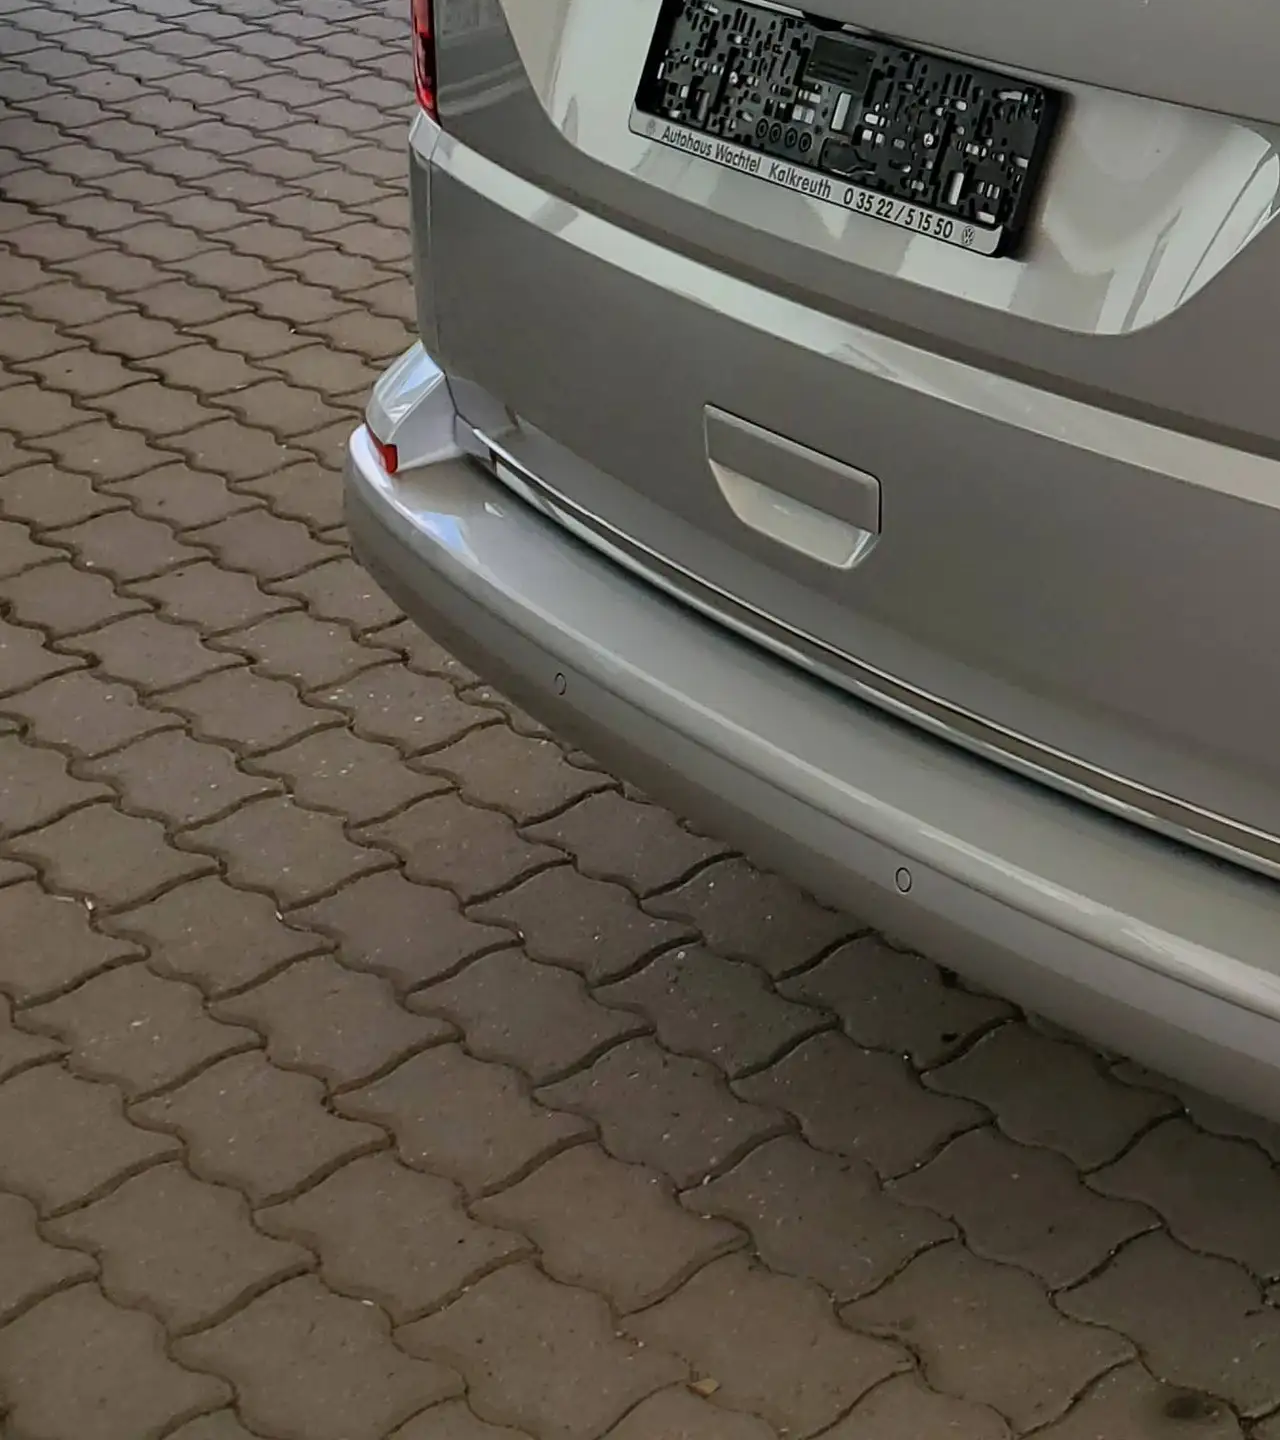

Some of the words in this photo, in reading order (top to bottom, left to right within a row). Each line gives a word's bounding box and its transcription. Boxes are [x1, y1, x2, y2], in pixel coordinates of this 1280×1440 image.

[661, 125, 712, 157] Autohaus
[715, 143, 762, 173] Wachtel
[768, 162, 832, 199] Kalkreuth
[856, 191, 873, 212] 35
[876, 198, 894, 219] 22
[904, 209, 915, 226] 5
[917, 212, 932, 231] 15
[934, 218, 953, 239] 50
